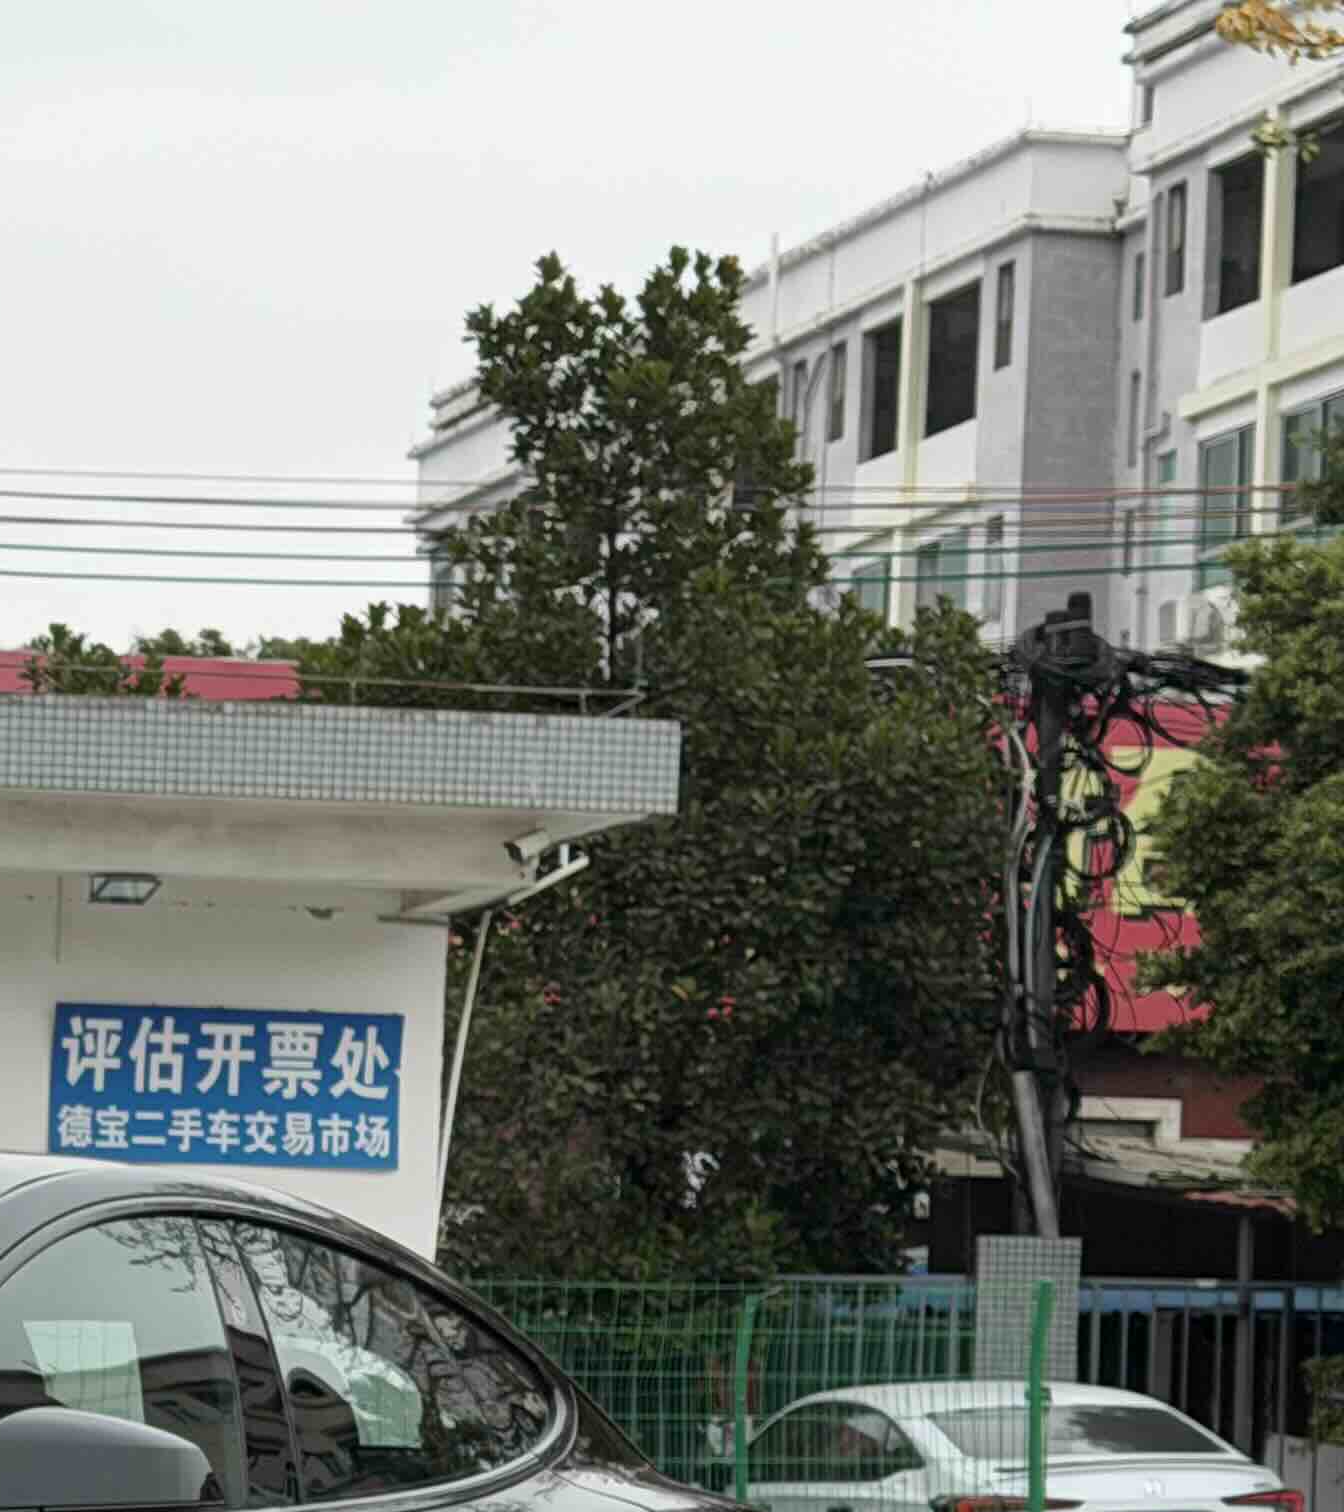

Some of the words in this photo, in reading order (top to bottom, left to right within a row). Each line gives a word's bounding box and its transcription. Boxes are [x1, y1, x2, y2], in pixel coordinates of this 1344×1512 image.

[62, 1015, 390, 1100] 评估开票处
[58, 1103, 390, 1158] 德宝二手车交易市场
